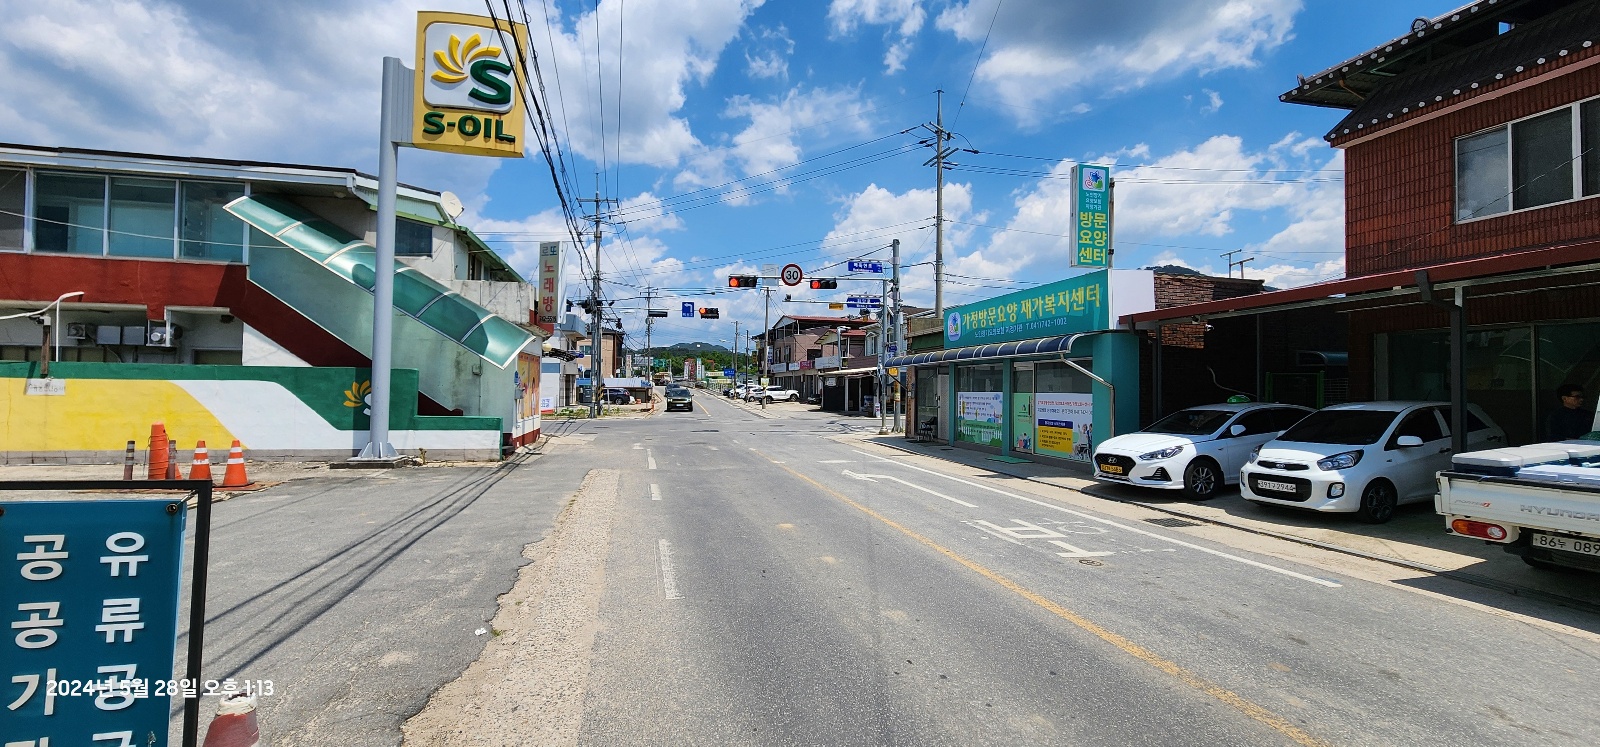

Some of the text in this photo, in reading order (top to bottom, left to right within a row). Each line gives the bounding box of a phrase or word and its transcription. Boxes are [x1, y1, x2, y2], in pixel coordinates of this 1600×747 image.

[423, 111, 516, 143] S-OIL
[1079, 211, 1107, 229] 방문
[1079, 229, 1107, 247] 요양
[541, 245, 557, 256] 로또
[1079, 246, 1106, 265] 센터
[785, 270, 799, 280] 30
[542, 259, 555, 313] 노래방
[962, 283, 1100, 330] 가정방문요양 재가복지센터
[1540, 536, 1567, 549] 86누
